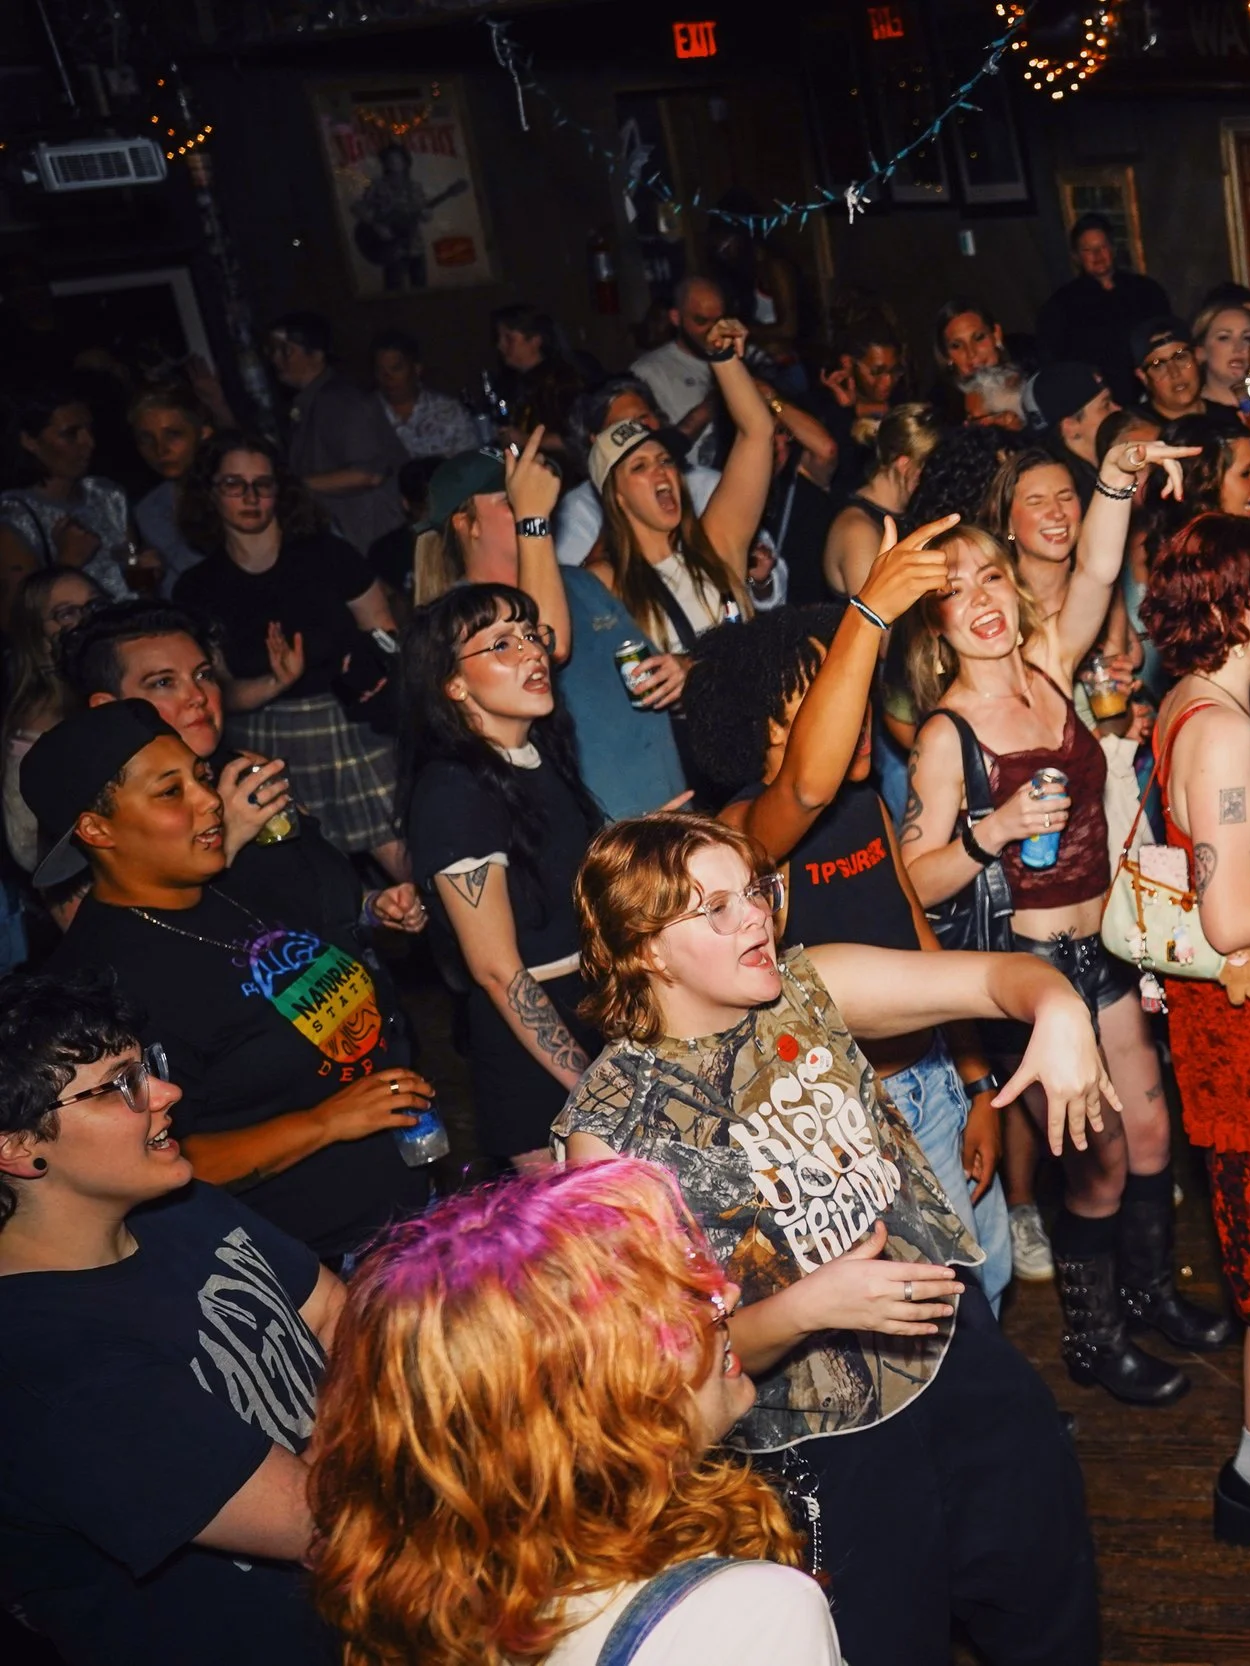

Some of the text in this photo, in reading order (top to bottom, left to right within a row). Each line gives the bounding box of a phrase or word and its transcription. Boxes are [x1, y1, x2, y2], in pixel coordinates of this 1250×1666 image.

[673, 22, 716, 58] EXIT
[291, 956, 360, 1021] NATURAL
[312, 972, 370, 1033] STATE
